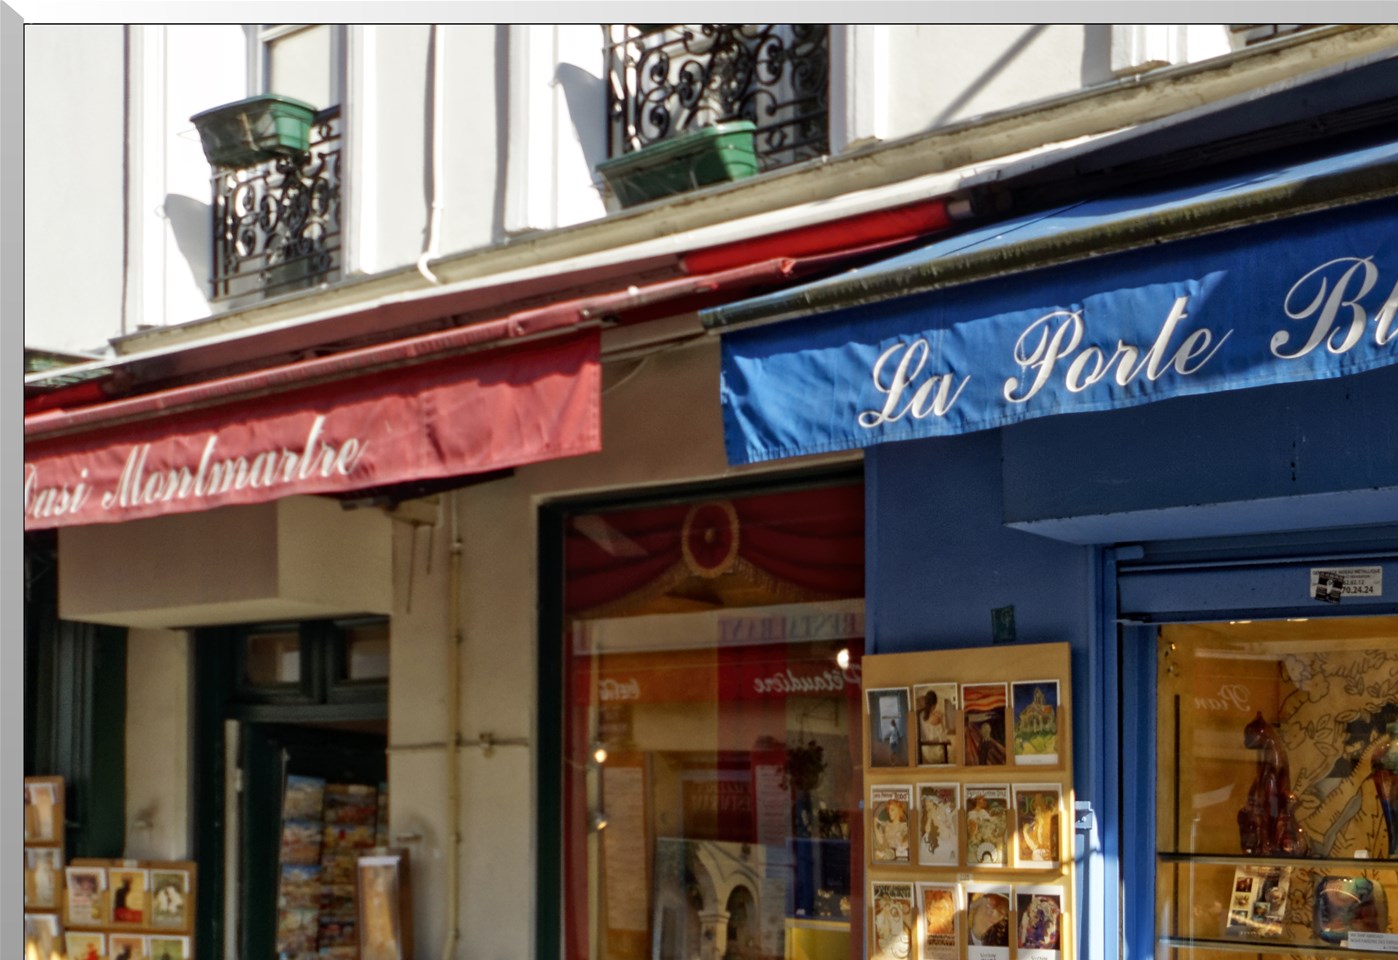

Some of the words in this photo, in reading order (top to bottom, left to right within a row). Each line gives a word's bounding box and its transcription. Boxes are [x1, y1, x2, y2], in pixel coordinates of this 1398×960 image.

[857, 338, 970, 430] La
[1002, 295, 1233, 405] Porte
[101, 415, 370, 510] Montmartre
